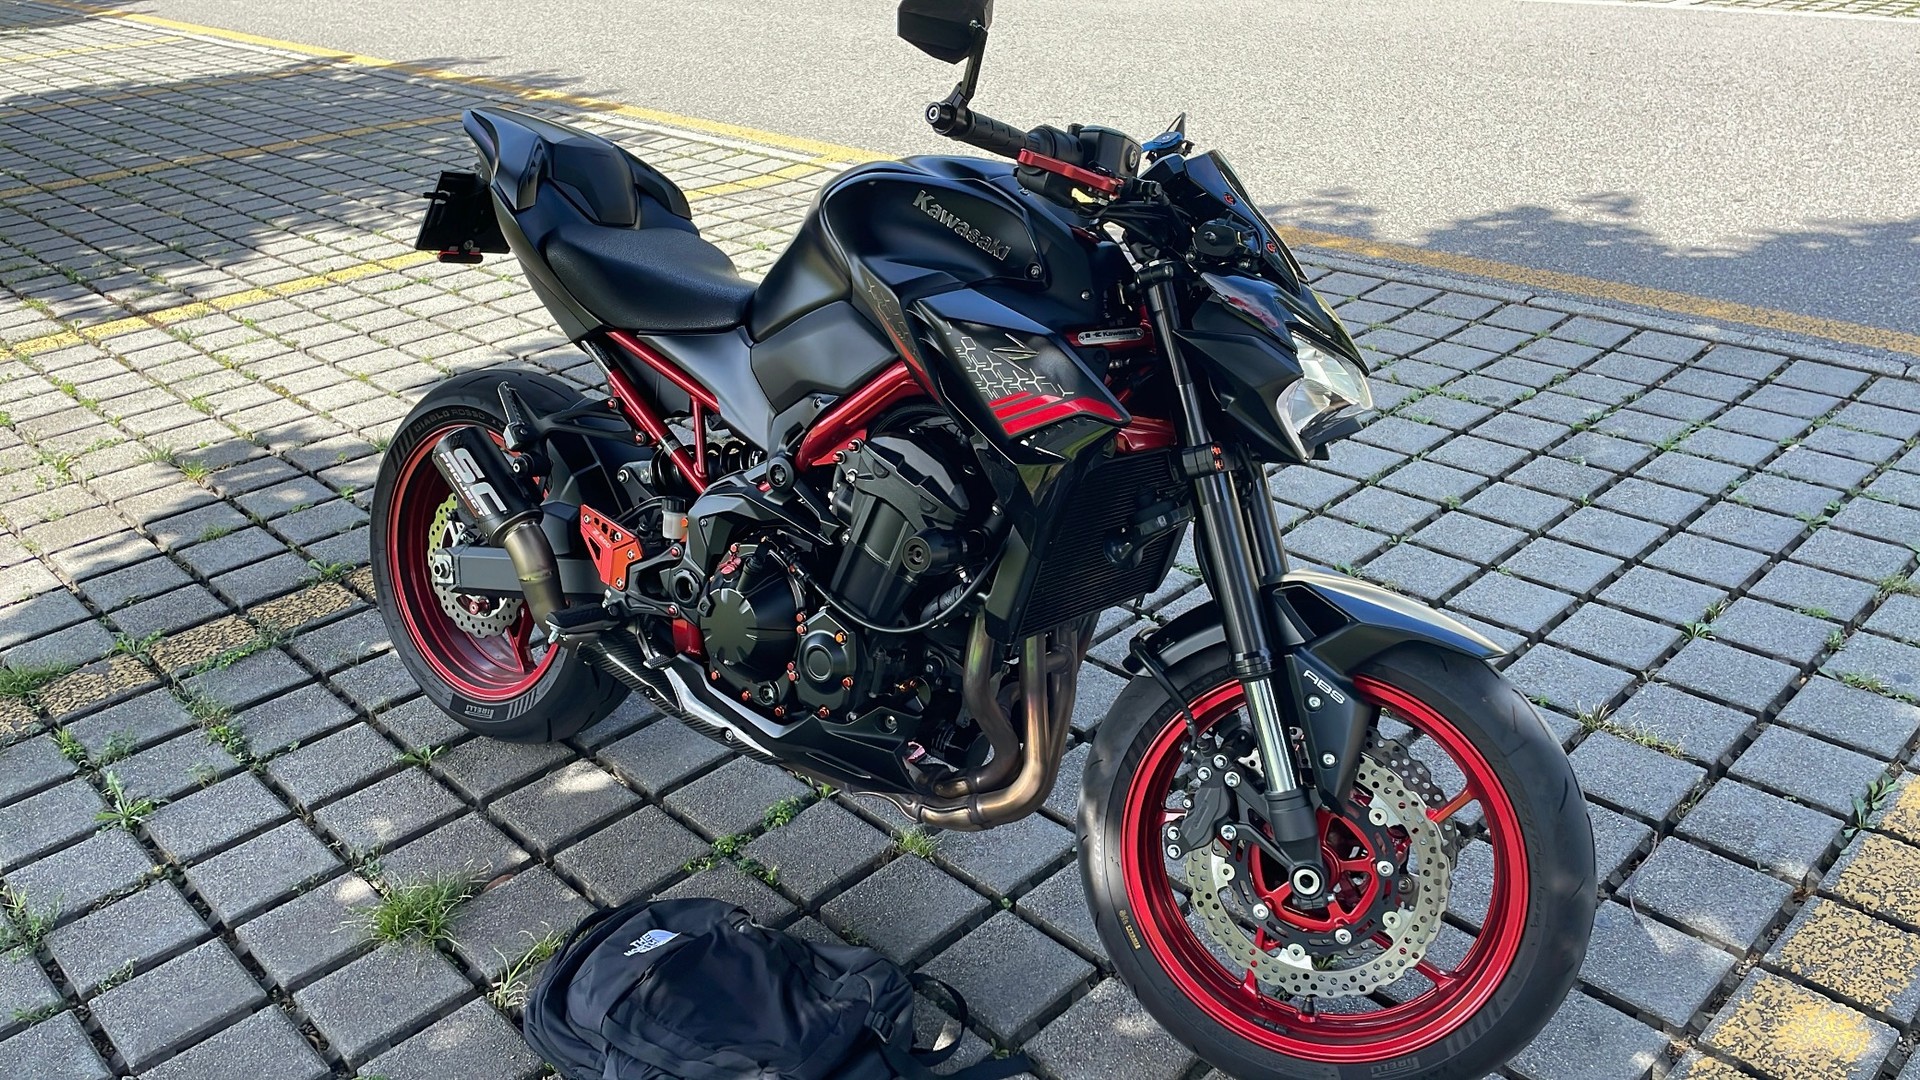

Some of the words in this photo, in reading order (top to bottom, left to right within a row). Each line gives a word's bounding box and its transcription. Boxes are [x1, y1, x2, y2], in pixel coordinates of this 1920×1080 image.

[912, 189, 1012, 261] Kawasaki
[413, 409, 451, 433] DIABLO
[451, 408, 486, 420] ROSSO
[439, 452, 487, 517] PROJECT
[444, 446, 508, 517] SC
[1303, 669, 1346, 704] ABS
[464, 704, 495, 719] PIRELLI
[629, 931, 653, 947] THE
[1370, 1056, 1420, 1079] PIRELLI
